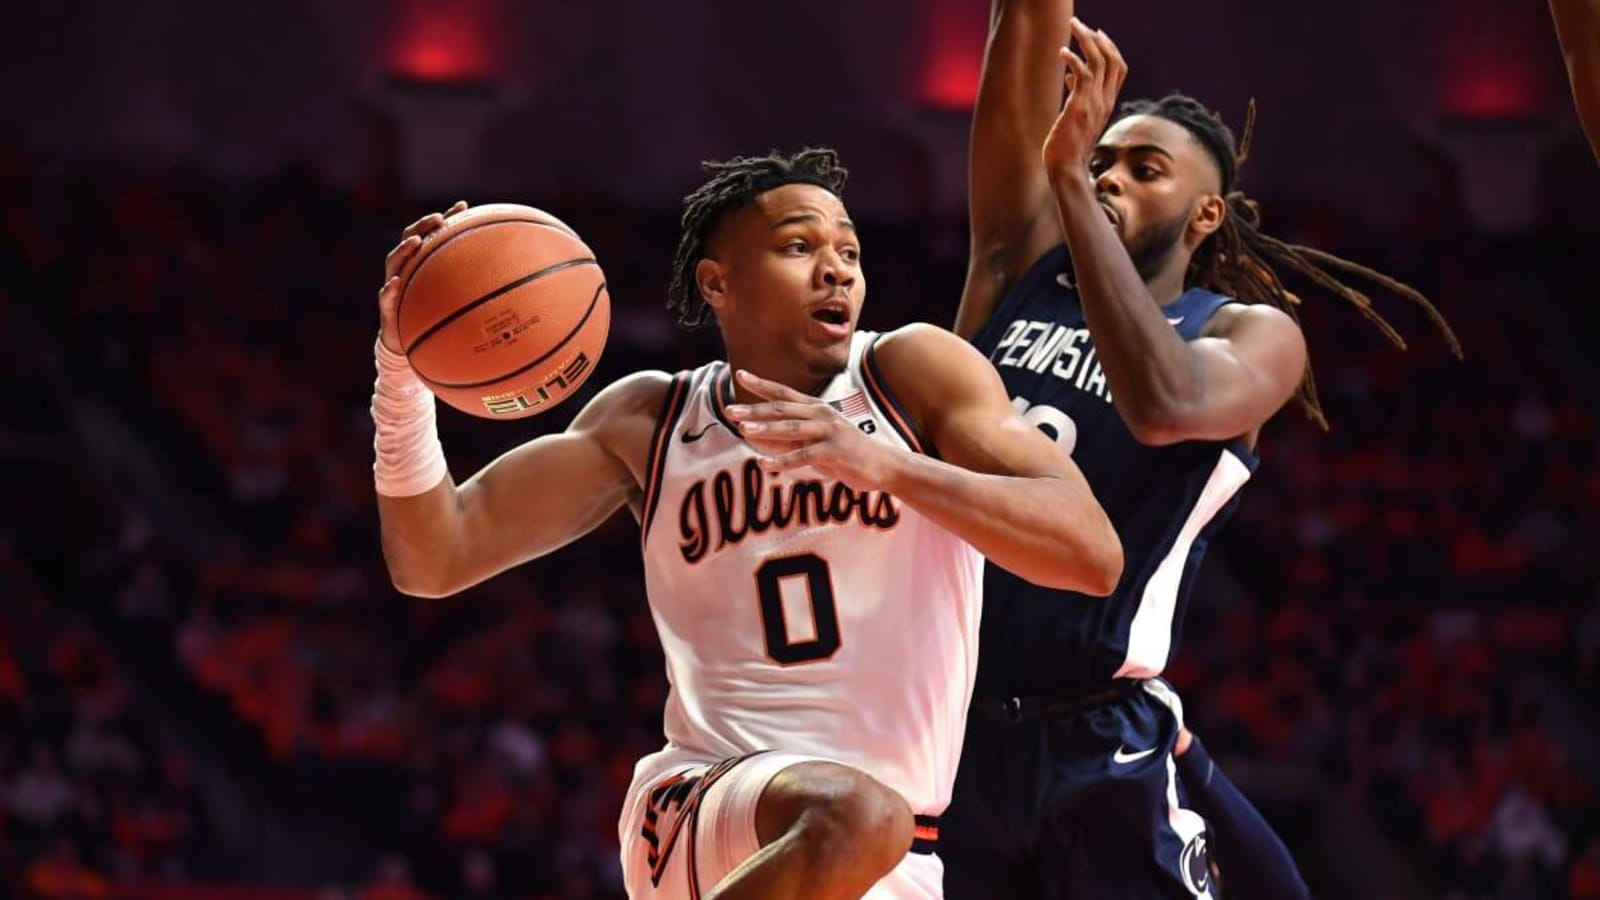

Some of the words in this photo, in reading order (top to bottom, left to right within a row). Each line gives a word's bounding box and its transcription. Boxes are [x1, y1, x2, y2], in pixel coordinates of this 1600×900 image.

[482, 351, 590, 415] ELITE
[679, 456, 900, 566] Illinois
[754, 550, 843, 667] 0
